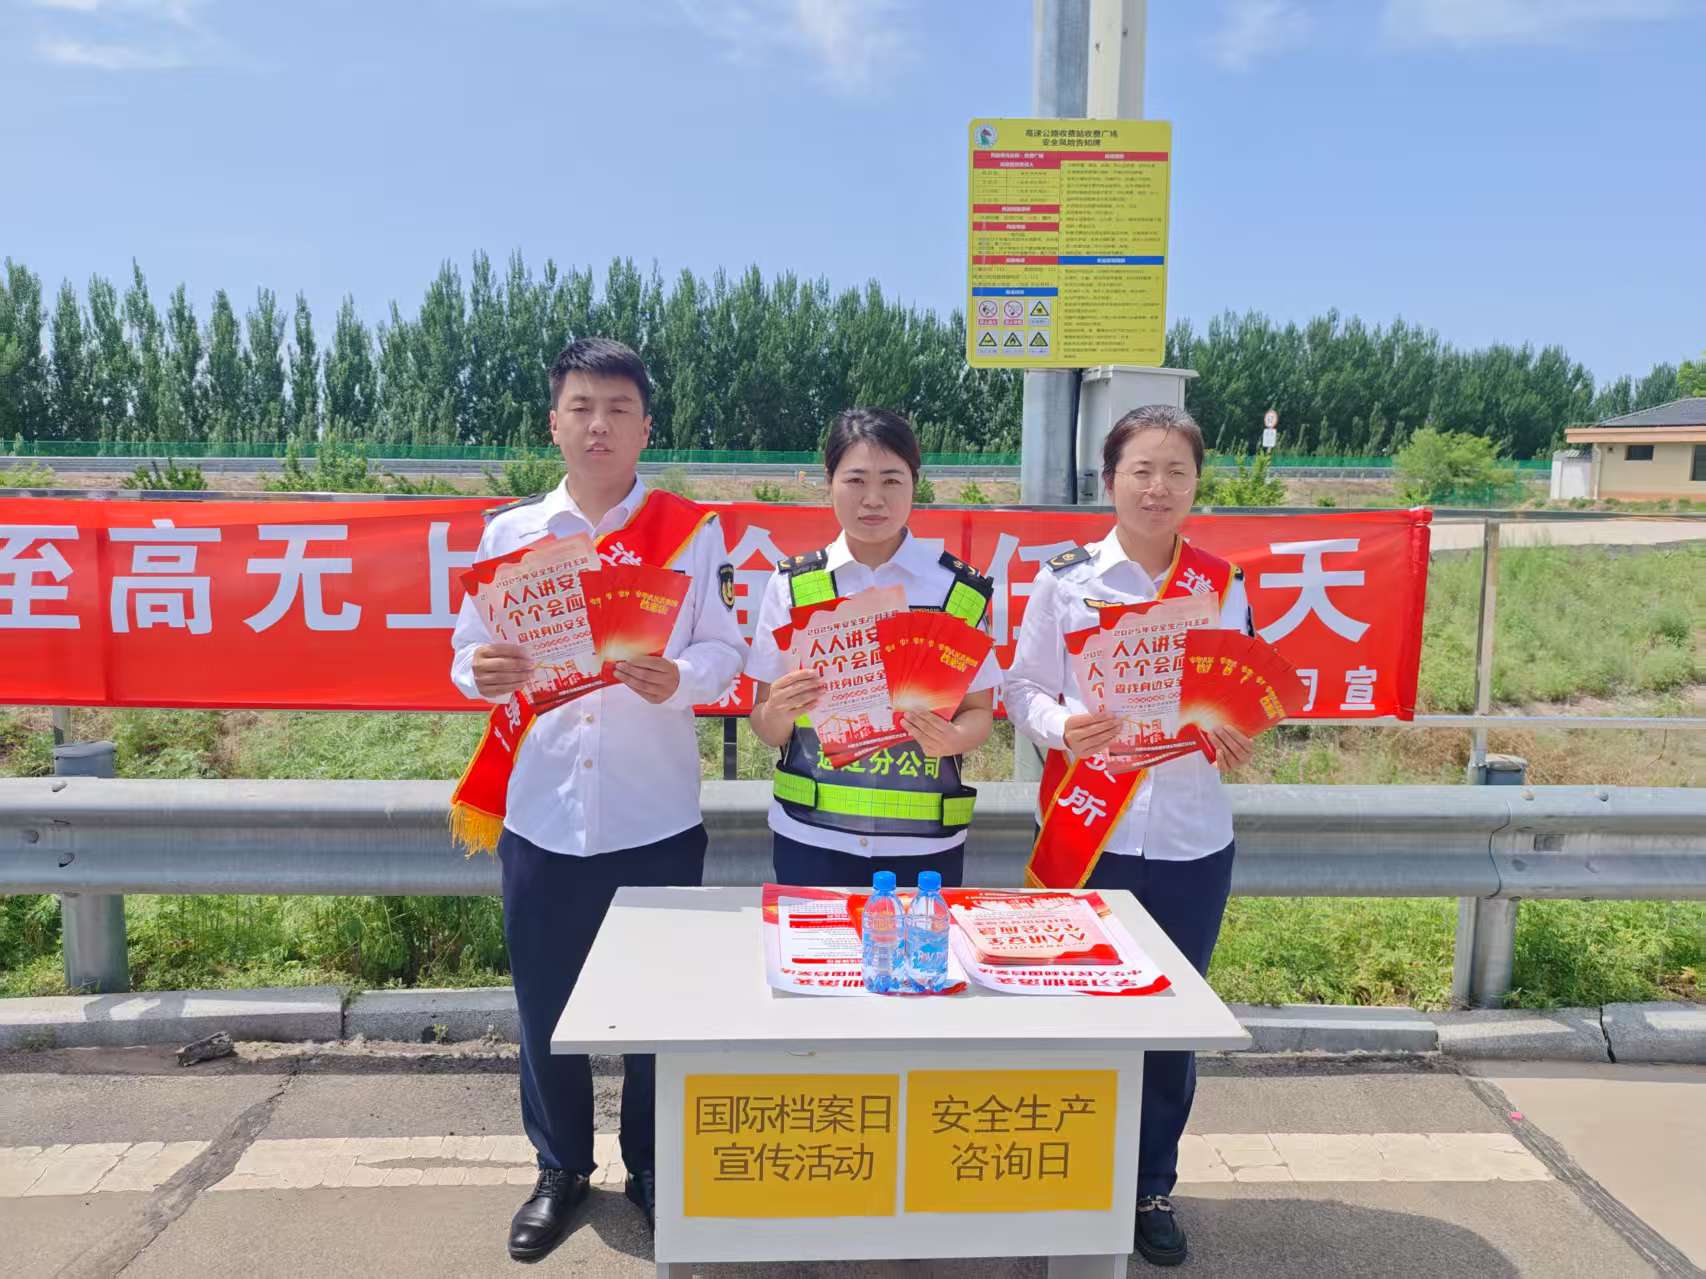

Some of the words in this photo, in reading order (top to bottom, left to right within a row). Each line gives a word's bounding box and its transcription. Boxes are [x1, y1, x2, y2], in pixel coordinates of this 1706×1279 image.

[0, 519, 478, 635] 至高无上
[695, 1094, 892, 1136] 国际档案日
[932, 1093, 1096, 1134] 安全生产
[713, 1142, 874, 1181] 宣传活动
[951, 1141, 1070, 1181] 咨询日
